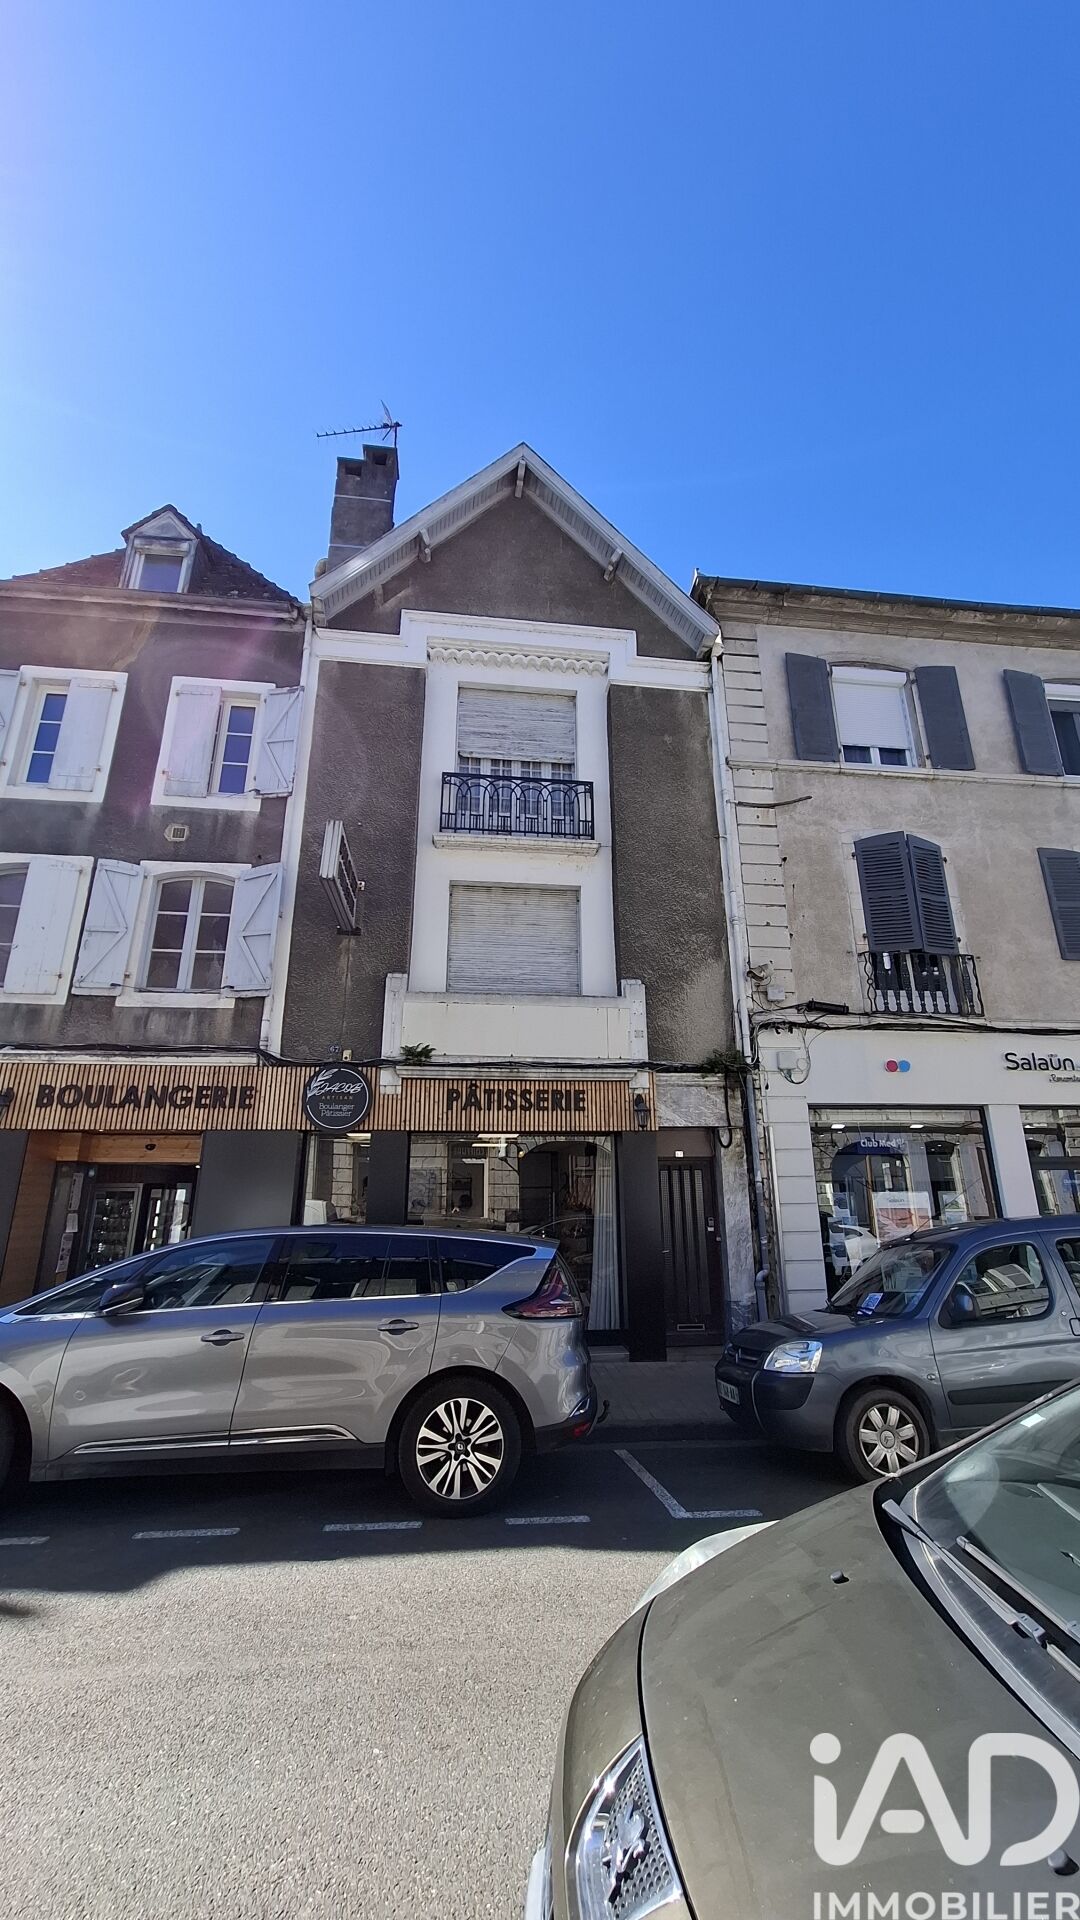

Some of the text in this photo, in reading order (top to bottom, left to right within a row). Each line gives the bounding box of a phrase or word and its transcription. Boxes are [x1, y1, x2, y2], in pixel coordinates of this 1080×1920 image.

[315, 1082, 364, 1096] JACOB
[36, 1083, 255, 1110] BOULANGERIE
[447, 1080, 586, 1112] PÂTISSERIE
[318, 1102, 355, 1111] Boulanger
[320, 1109, 352, 1117] Pâtissier
[860, 1138, 897, 1148] Club Med
